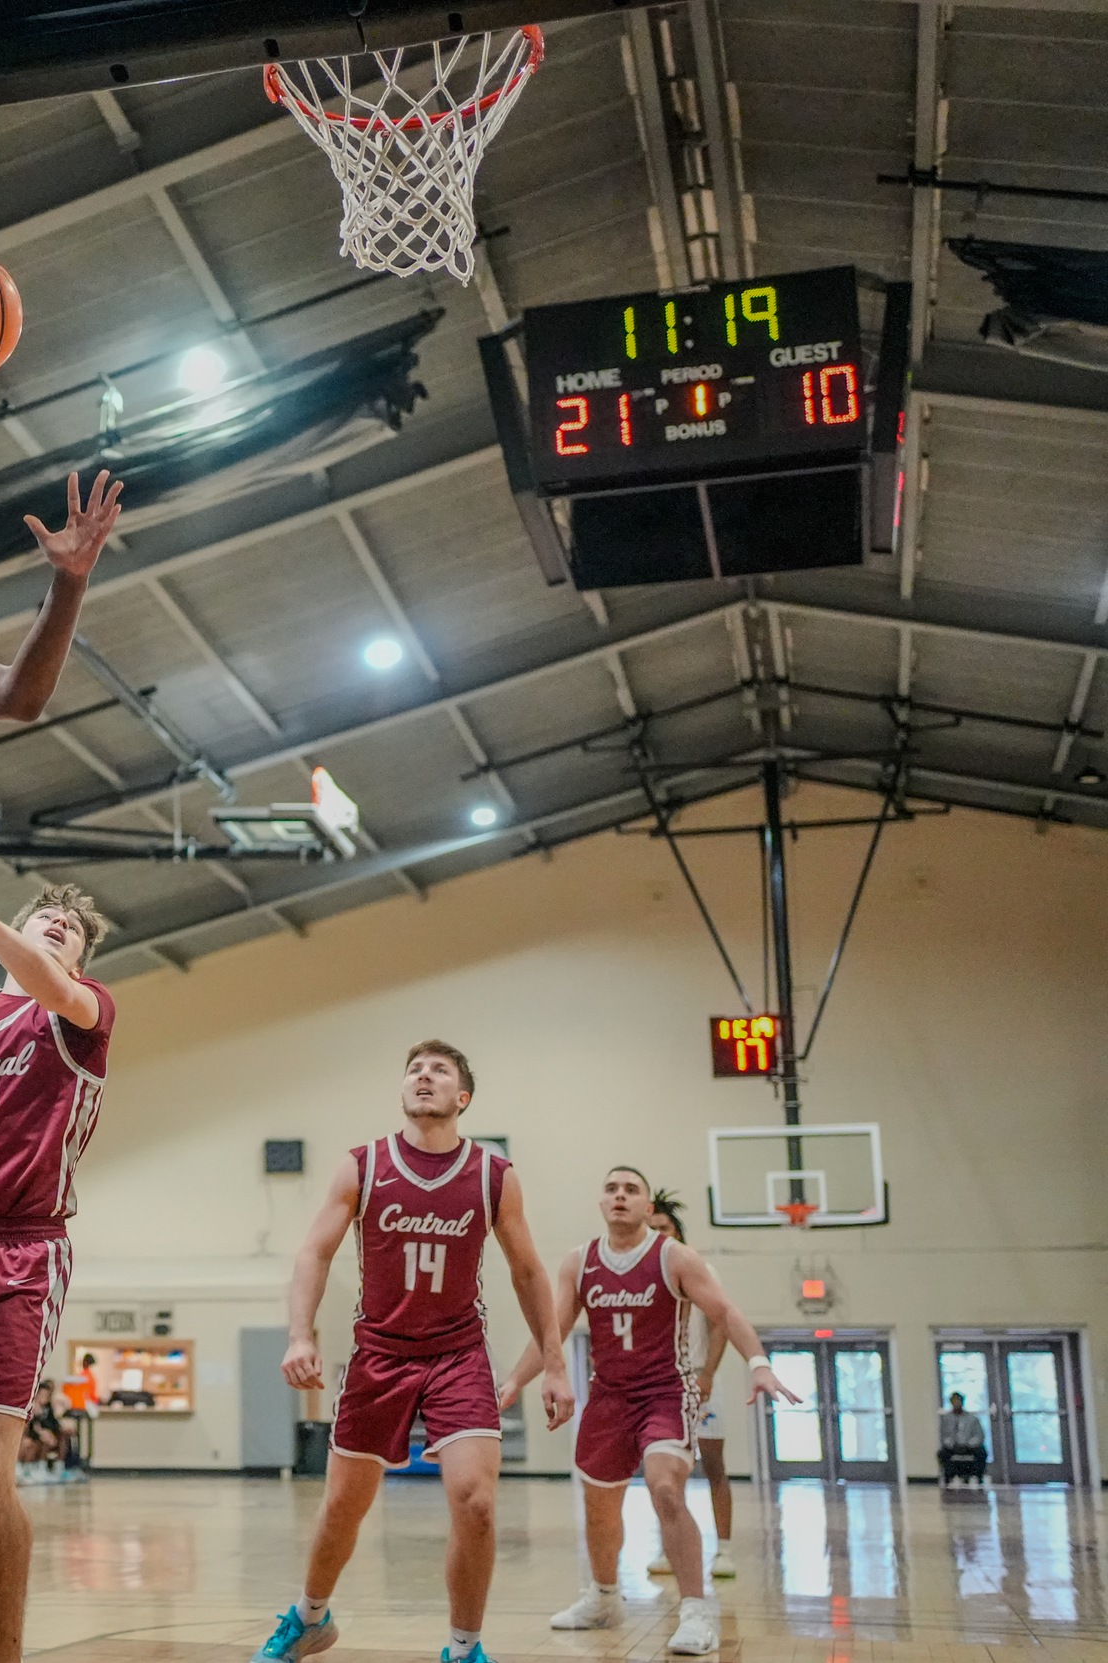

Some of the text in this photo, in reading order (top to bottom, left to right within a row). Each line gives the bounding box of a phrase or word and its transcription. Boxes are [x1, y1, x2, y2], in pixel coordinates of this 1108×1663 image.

[624, 286, 779, 360] 11:19
[769, 340, 843, 368] GUEST
[556, 367, 623, 394] HOME
[660, 363, 723, 385] PERIOD
[695, 383, 707, 416] 1
[802, 364, 859, 425] 10
[555, 393, 632, 456] 21
[665, 420, 727, 442] BONUS
[736, 1037, 769, 1073] 17
[378, 1203, 475, 1239] Central
[402, 1242, 448, 1294] 14
[586, 1283, 657, 1310] Central
[612, 1313, 634, 1351] 4
